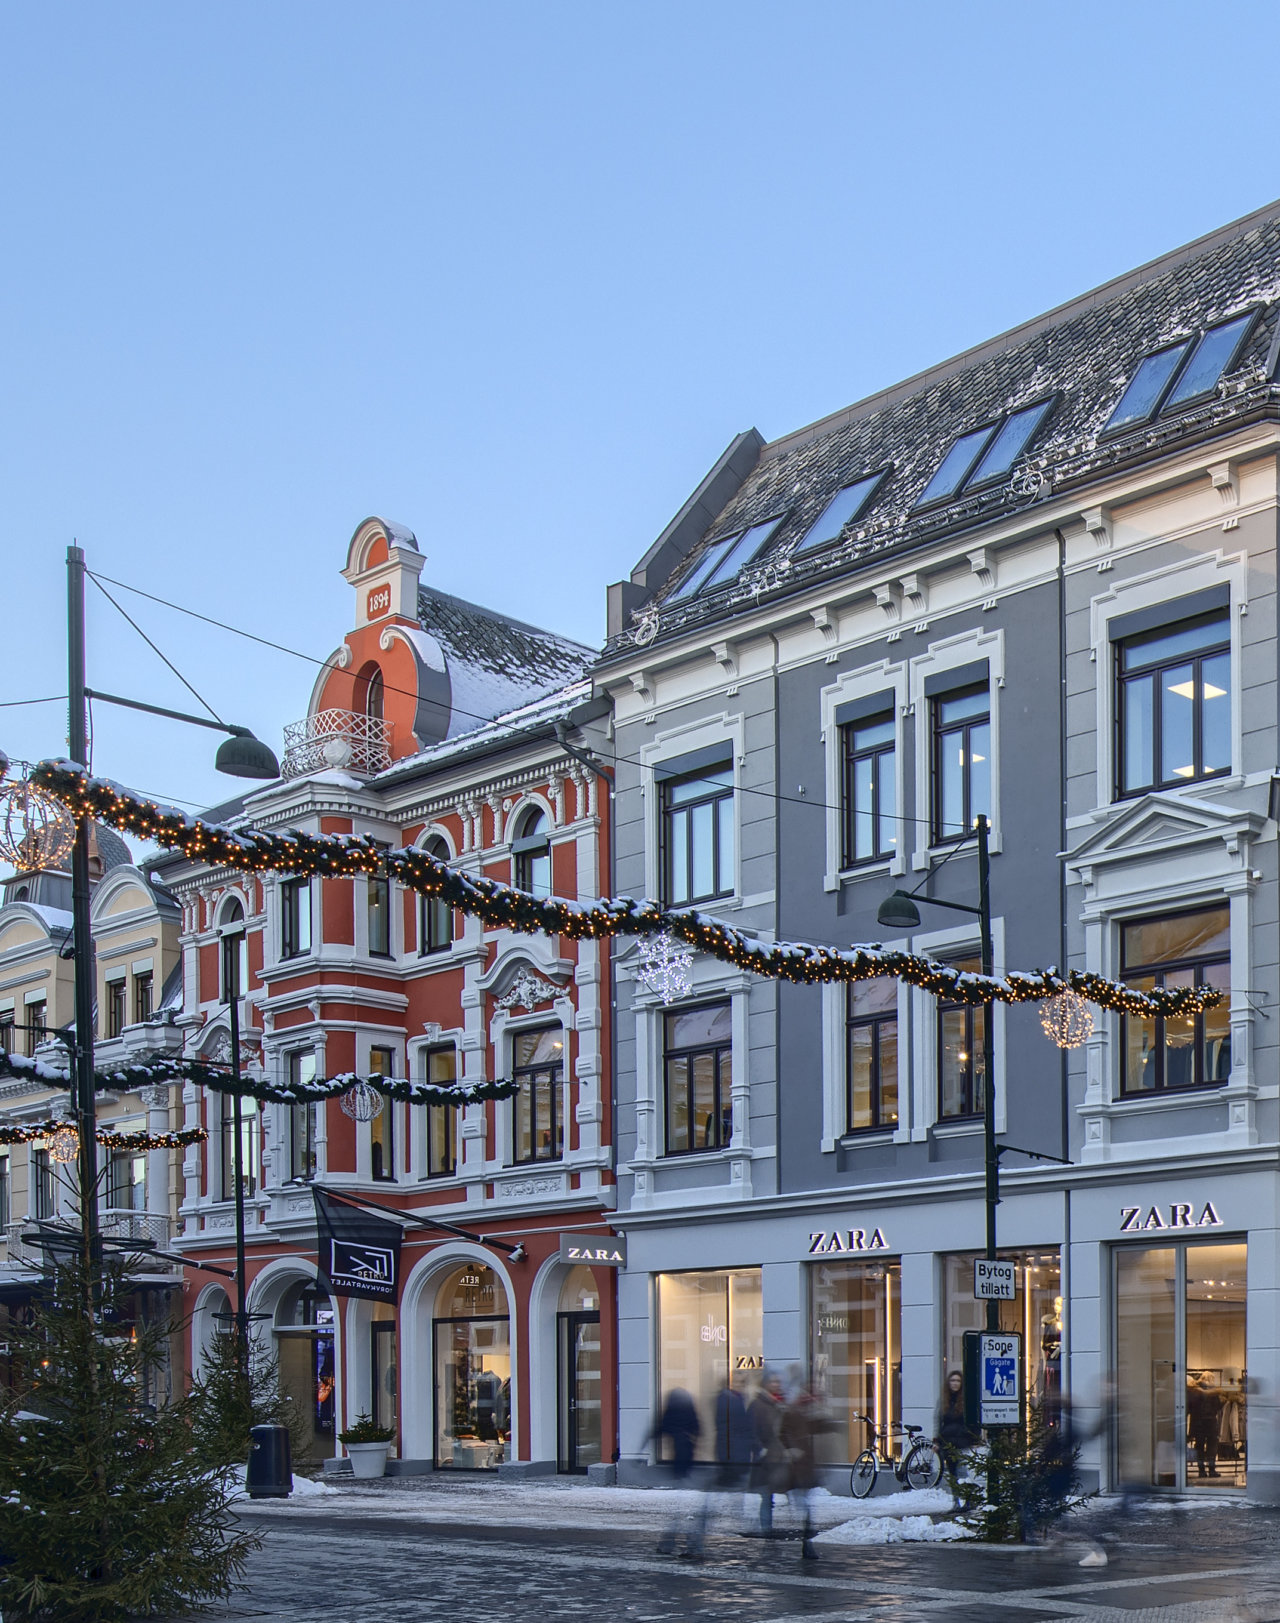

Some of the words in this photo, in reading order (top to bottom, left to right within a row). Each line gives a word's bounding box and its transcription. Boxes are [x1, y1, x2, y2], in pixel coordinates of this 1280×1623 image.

[369, 590, 389, 612] 1894
[1120, 1202, 1224, 1232] ZARA
[808, 1227, 890, 1254] ZARA
[567, 1247, 624, 1261] ZARA
[978, 1263, 1012, 1281] Bytog
[980, 1282, 1010, 1296] tillatt
[987, 1339, 1013, 1351] Sone
